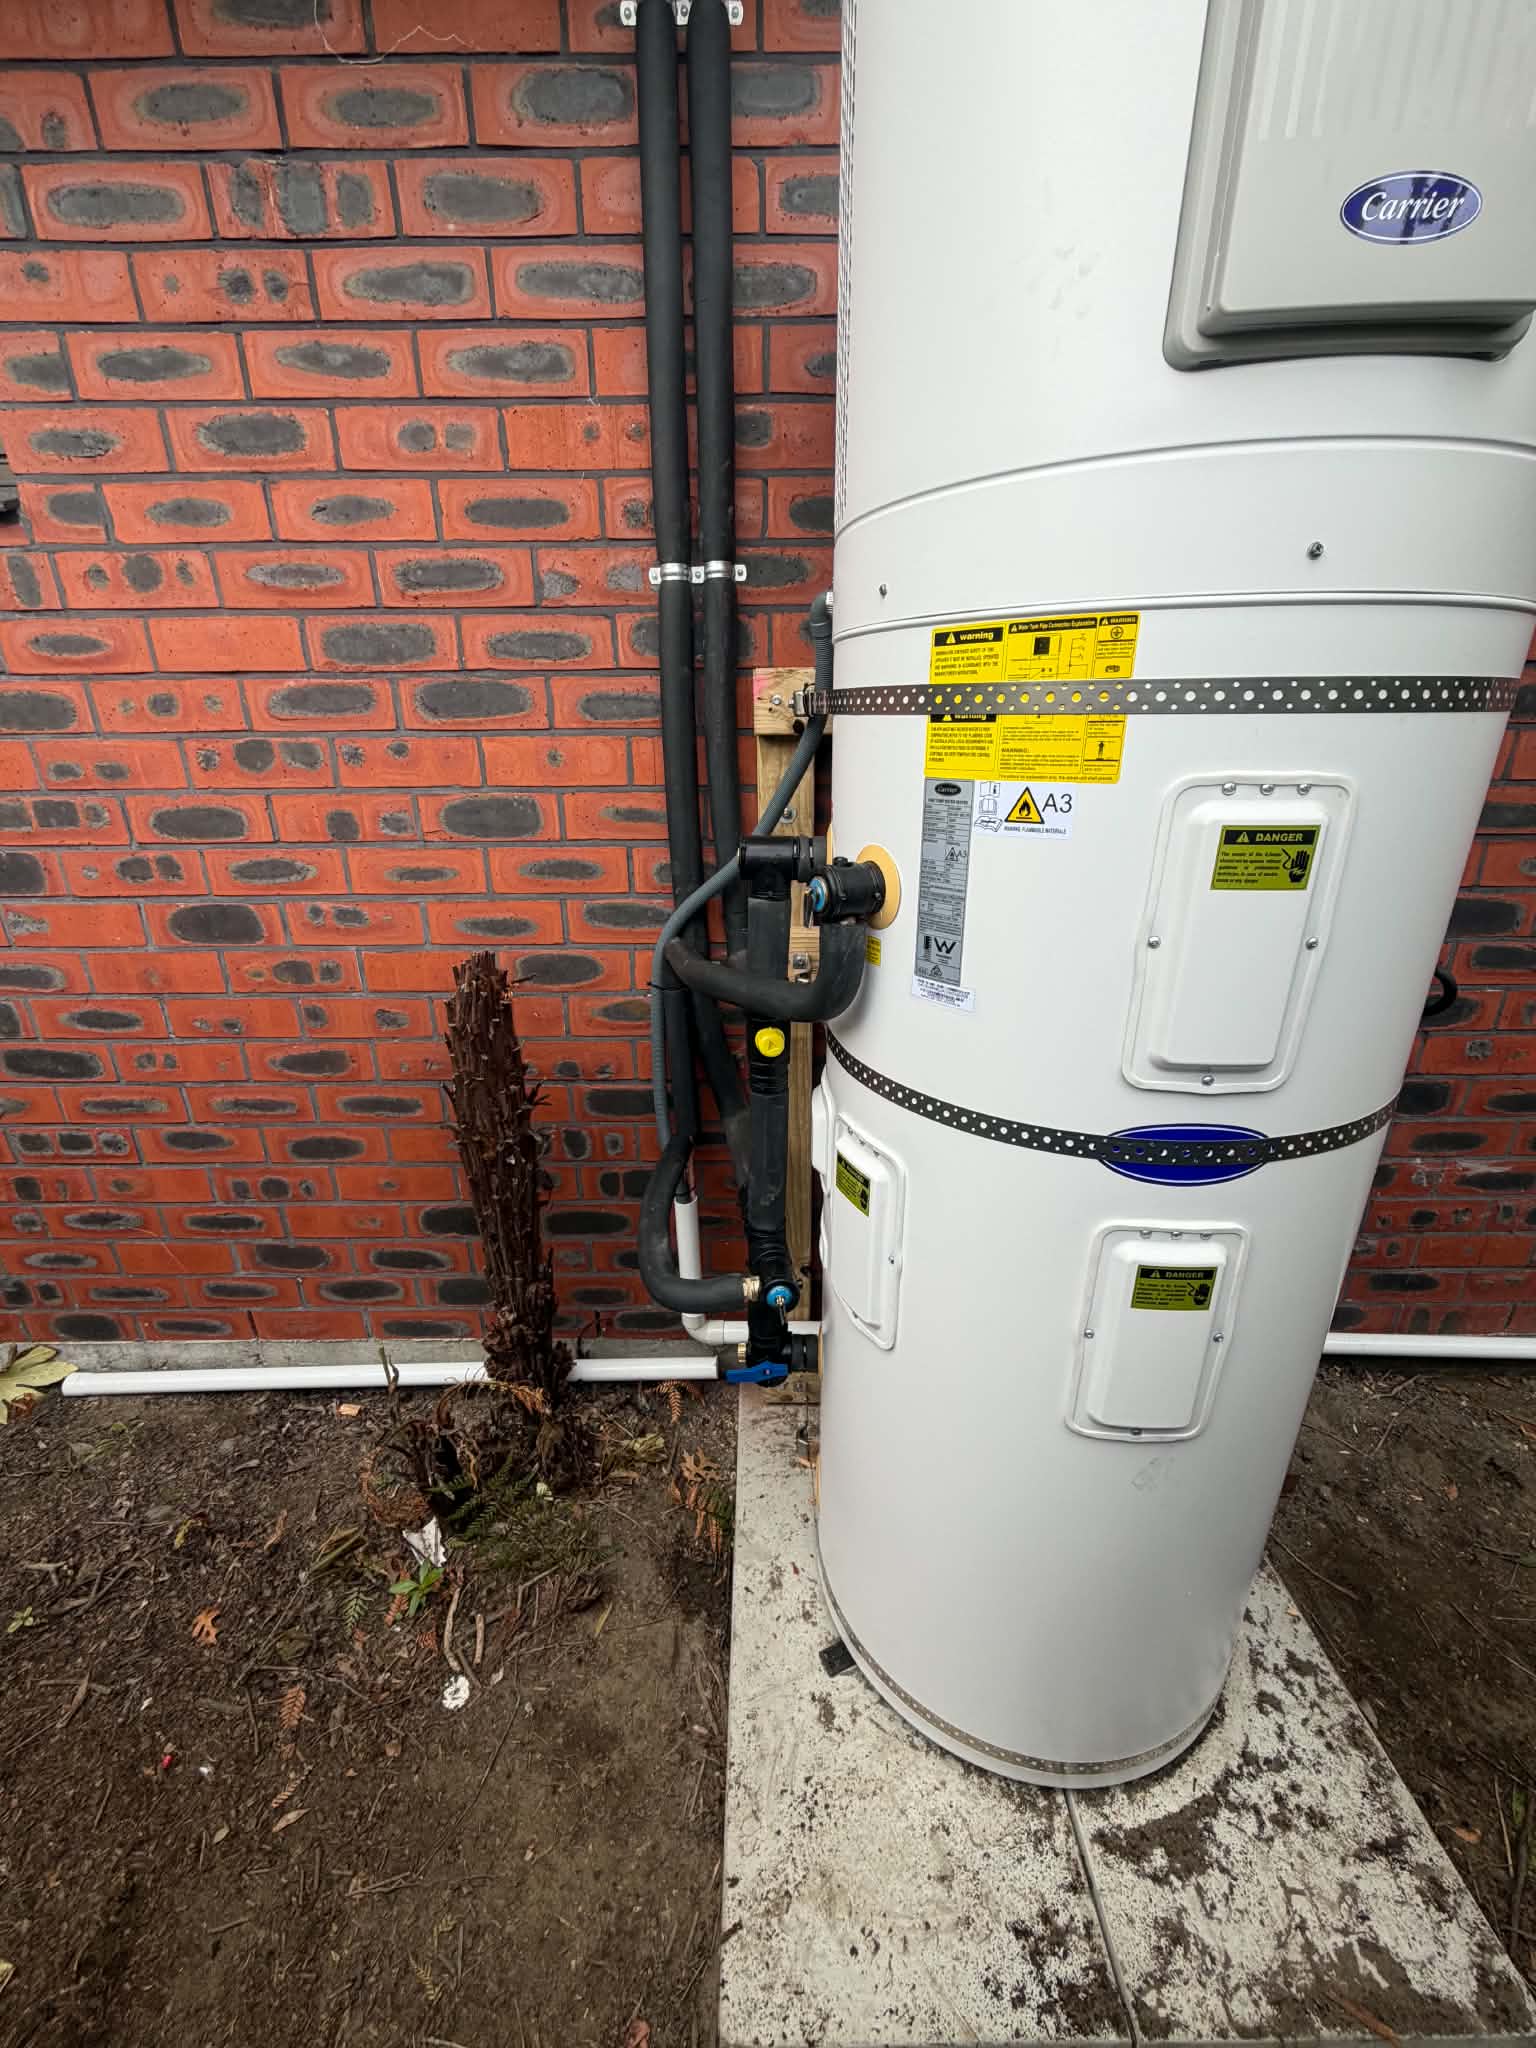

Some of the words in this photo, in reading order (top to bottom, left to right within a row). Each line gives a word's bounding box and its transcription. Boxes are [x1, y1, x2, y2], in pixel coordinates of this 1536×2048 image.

[1361, 191, 1465, 221] Carrier
[960, 631, 994, 641] warning
[1042, 793, 1072, 814] A3
[1255, 832, 1304, 842] DANGER
[1165, 1271, 1204, 1279] DANGER
